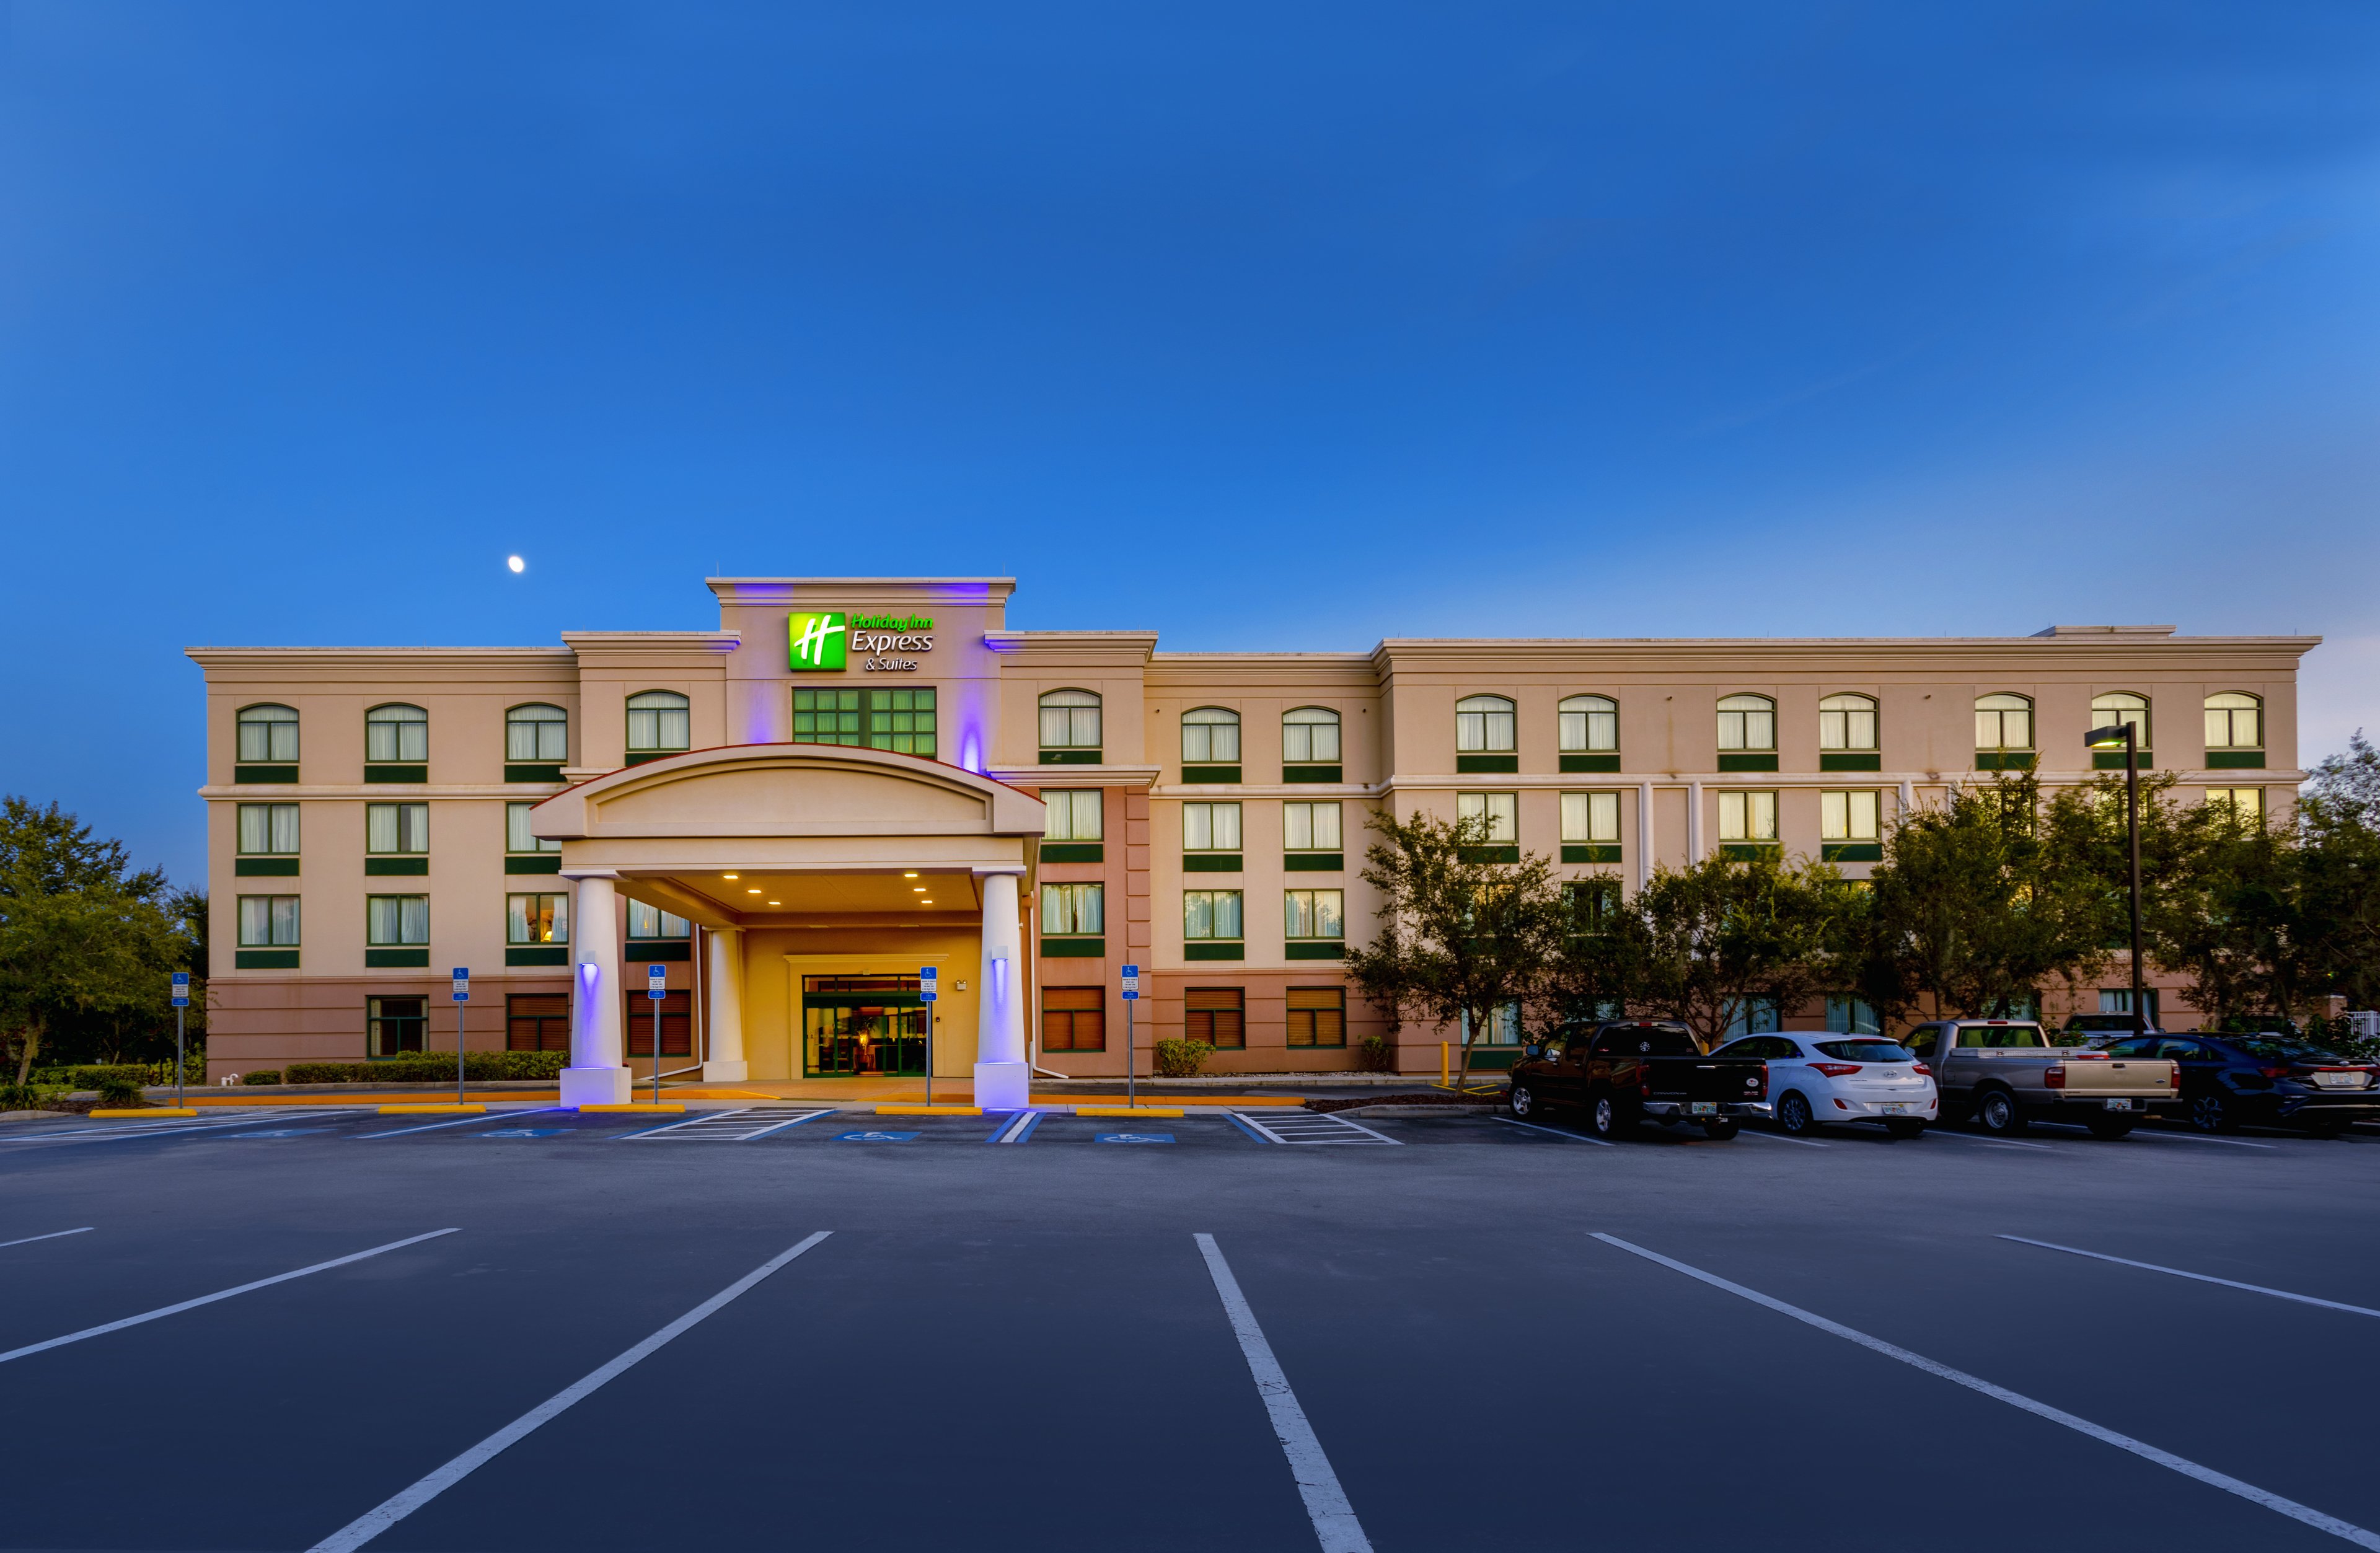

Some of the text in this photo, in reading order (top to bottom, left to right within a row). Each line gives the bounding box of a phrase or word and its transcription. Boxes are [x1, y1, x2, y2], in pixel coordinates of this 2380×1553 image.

[851, 614, 933, 632] Holiday Inn
[852, 630, 933, 656] Express
[865, 658, 918, 671] & Suites
